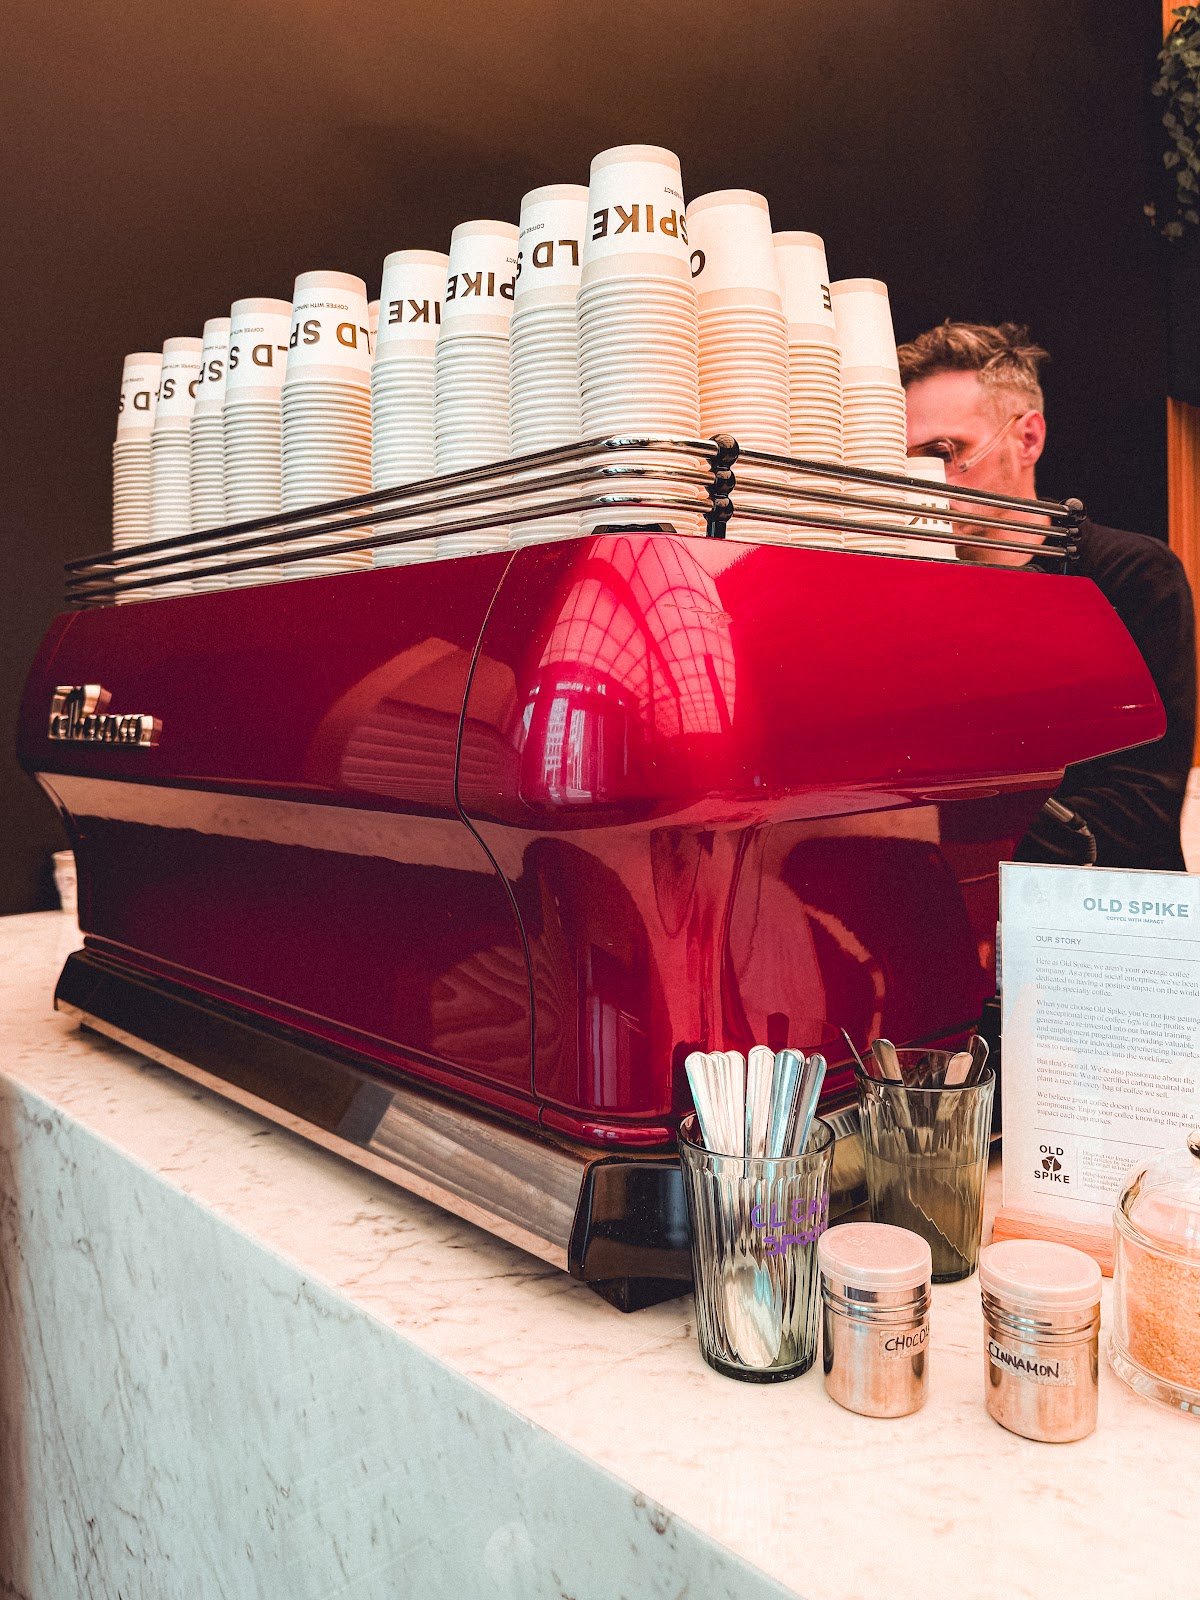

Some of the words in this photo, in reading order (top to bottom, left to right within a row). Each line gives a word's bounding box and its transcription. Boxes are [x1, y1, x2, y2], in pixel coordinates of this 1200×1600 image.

[592, 204, 689, 246] SPIKE
[326, 302, 349, 311] COFFEE
[1083, 897, 1123, 913] OLD
[1128, 900, 1189, 918] SPIKE
[1035, 935, 1053, 943] OUR
[1055, 937, 1082, 945] STORY
[1060, 959, 1072, 967] Old
[1125, 966, 1140, 974] your
[1141, 968, 1168, 977] average
[1035, 975, 1067, 984] dedicated
[1076, 978, 1098, 987] having
[1105, 981, 1131, 991] positive
[1132, 984, 1155, 993] impact
[1166, 987, 1179, 995] the
[1179, 989, 1200, 997] world
[1036, 982, 1061, 993] through
[1062, 986, 1090, 996] specialty
[1083, 971, 1103, 979] proud
[1181, 980, 1199, 988] been
[1036, 999, 1056, 1007] When
[1056, 1002, 1069, 1010] you
[1093, 1005, 1106, 1013] Old
[1163, 1013, 1176, 1021] just
[1046, 1010, 1083, 1019] exceptional
[1084, 1014, 1096, 1022] cup
[1163, 1022, 1185, 1030] profits
[1036, 1017, 1064, 1025] generate
[1076, 1022, 1112, 1031] re-invested
[1140, 1028, 1163, 1037] barista
[1164, 1031, 1192, 1041] training
[1049, 1027, 1090, 1037] employment
[1131, 1037, 1163, 1046] providing
[1164, 1040, 1194, 1050] valuable
[1036, 1034, 1079, 1043] opportunities
[1090, 1039, 1126, 1049] individuals
[1127, 1045, 1170, 1056] experiencing
[1059, 1044, 1094, 1055] reintegrate
[1094, 1048, 1111, 1057] back
[1112, 1051, 1126, 1059] into
[1126, 1052, 1137, 1060] the
[1036, 1057, 1048, 1065] But
[1125, 1070, 1161, 1081] passionate
[1162, 1074, 1182, 1083] about
[1183, 1076, 1196, 1085] the
[1079, 1071, 1091, 1079] We
[1103, 1076, 1130, 1085] certified
[1130, 1079, 1154, 1088] carbon
[1155, 1083, 1180, 1092] neutral
[1036, 1074, 1053, 1082] plant
[1059, 1078, 1072, 1086] tree
[1083, 1081, 1100, 1090] every
[1102, 1083, 1115, 1092] bag
[1123, 1087, 1144, 1095] coffee
[1037, 1091, 1048, 1099] We
[1048, 1093, 1071, 1102] believe
[1072, 1097, 1088, 1105] great
[1089, 1099, 1109, 1107] coffee
[1135, 1106, 1152, 1114] need
[1160, 1110, 1180, 1118] come
[1037, 1109, 1059, 1117] impact
[1059, 1111, 1075, 1119] each
[1076, 1115, 1089, 1123] cup
[1078, 1106, 1096, 1116] Enjoy
[1098, 1109, 1113, 1117] your
[1114, 1111, 1134, 1119] coffee
[1135, 1114, 1165, 1125] knowing
[1166, 1118, 1178, 1126] the
[1039, 1144, 1064, 1156] OLD
[1034, 1170, 1070, 1184] SPIKE
[884, 1321, 930, 1352] CHOCOL
[988, 1341, 1059, 1378] CINNAMON
